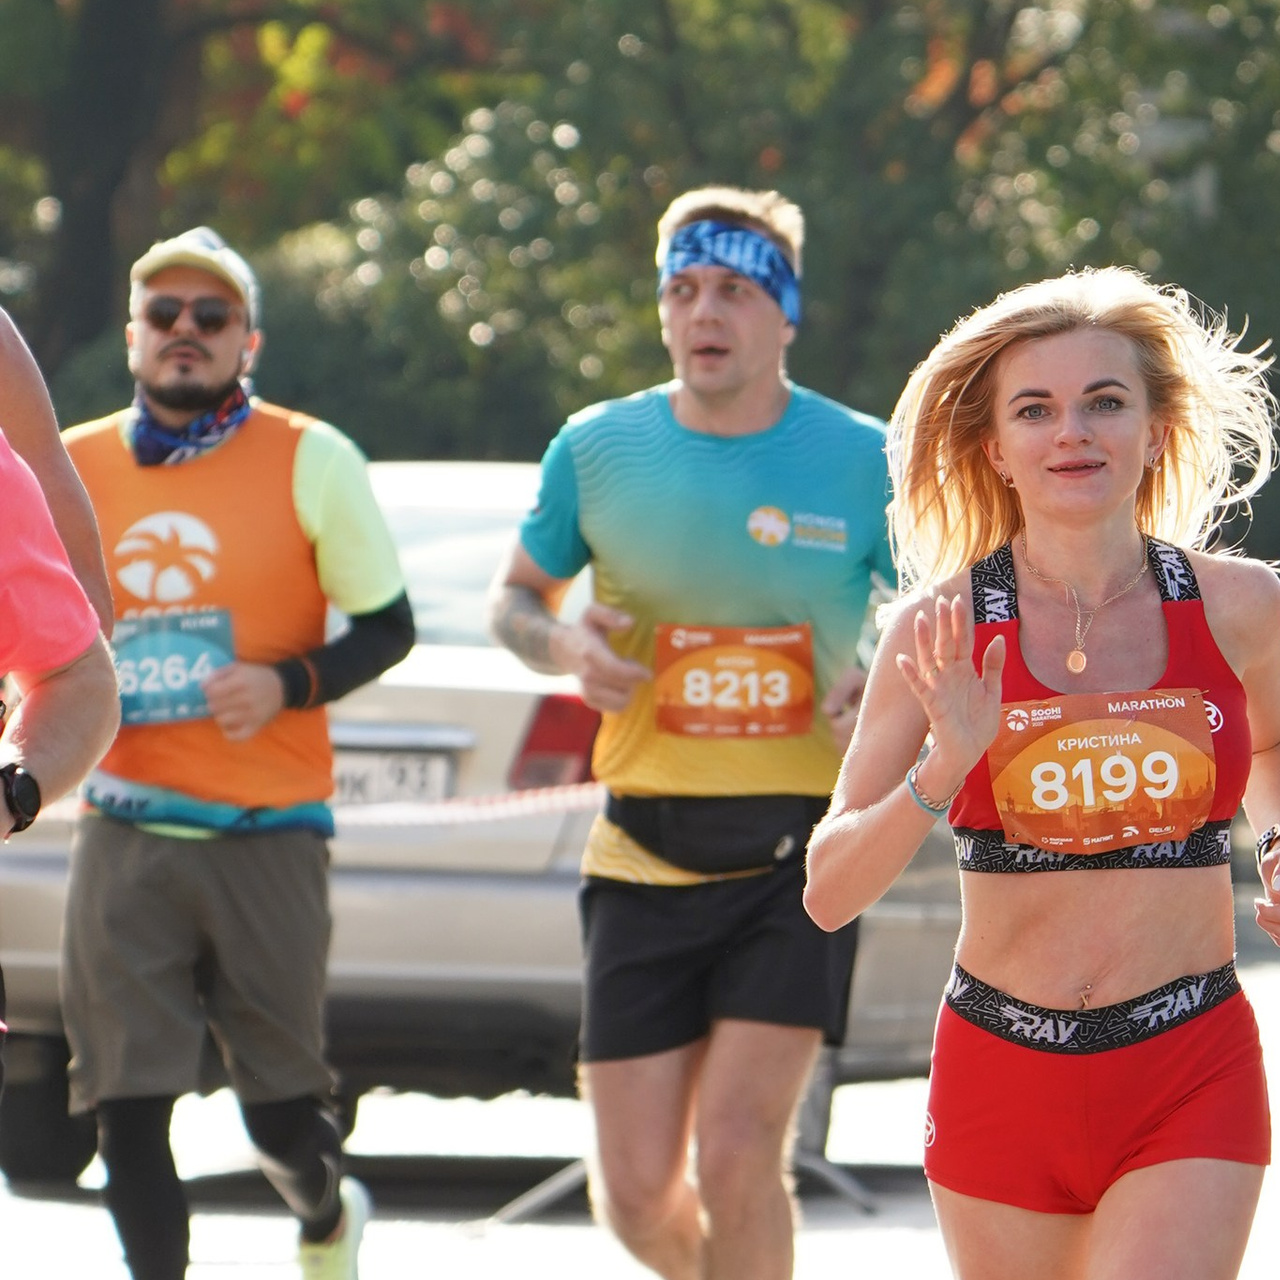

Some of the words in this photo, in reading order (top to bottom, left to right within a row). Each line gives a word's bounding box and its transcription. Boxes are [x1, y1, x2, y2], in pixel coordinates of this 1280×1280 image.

[119, 651, 213, 694] 6264
[683, 669, 790, 708] 8213
[1031, 706, 1062, 717] SOCHI
[1107, 697, 1186, 714] MARATHON
[1057, 732, 1142, 752] КРИСТИНА
[1030, 751, 1179, 811] 8199
[1128, 978, 1207, 1028] RAY
[1000, 1003, 1079, 1044] RAY
